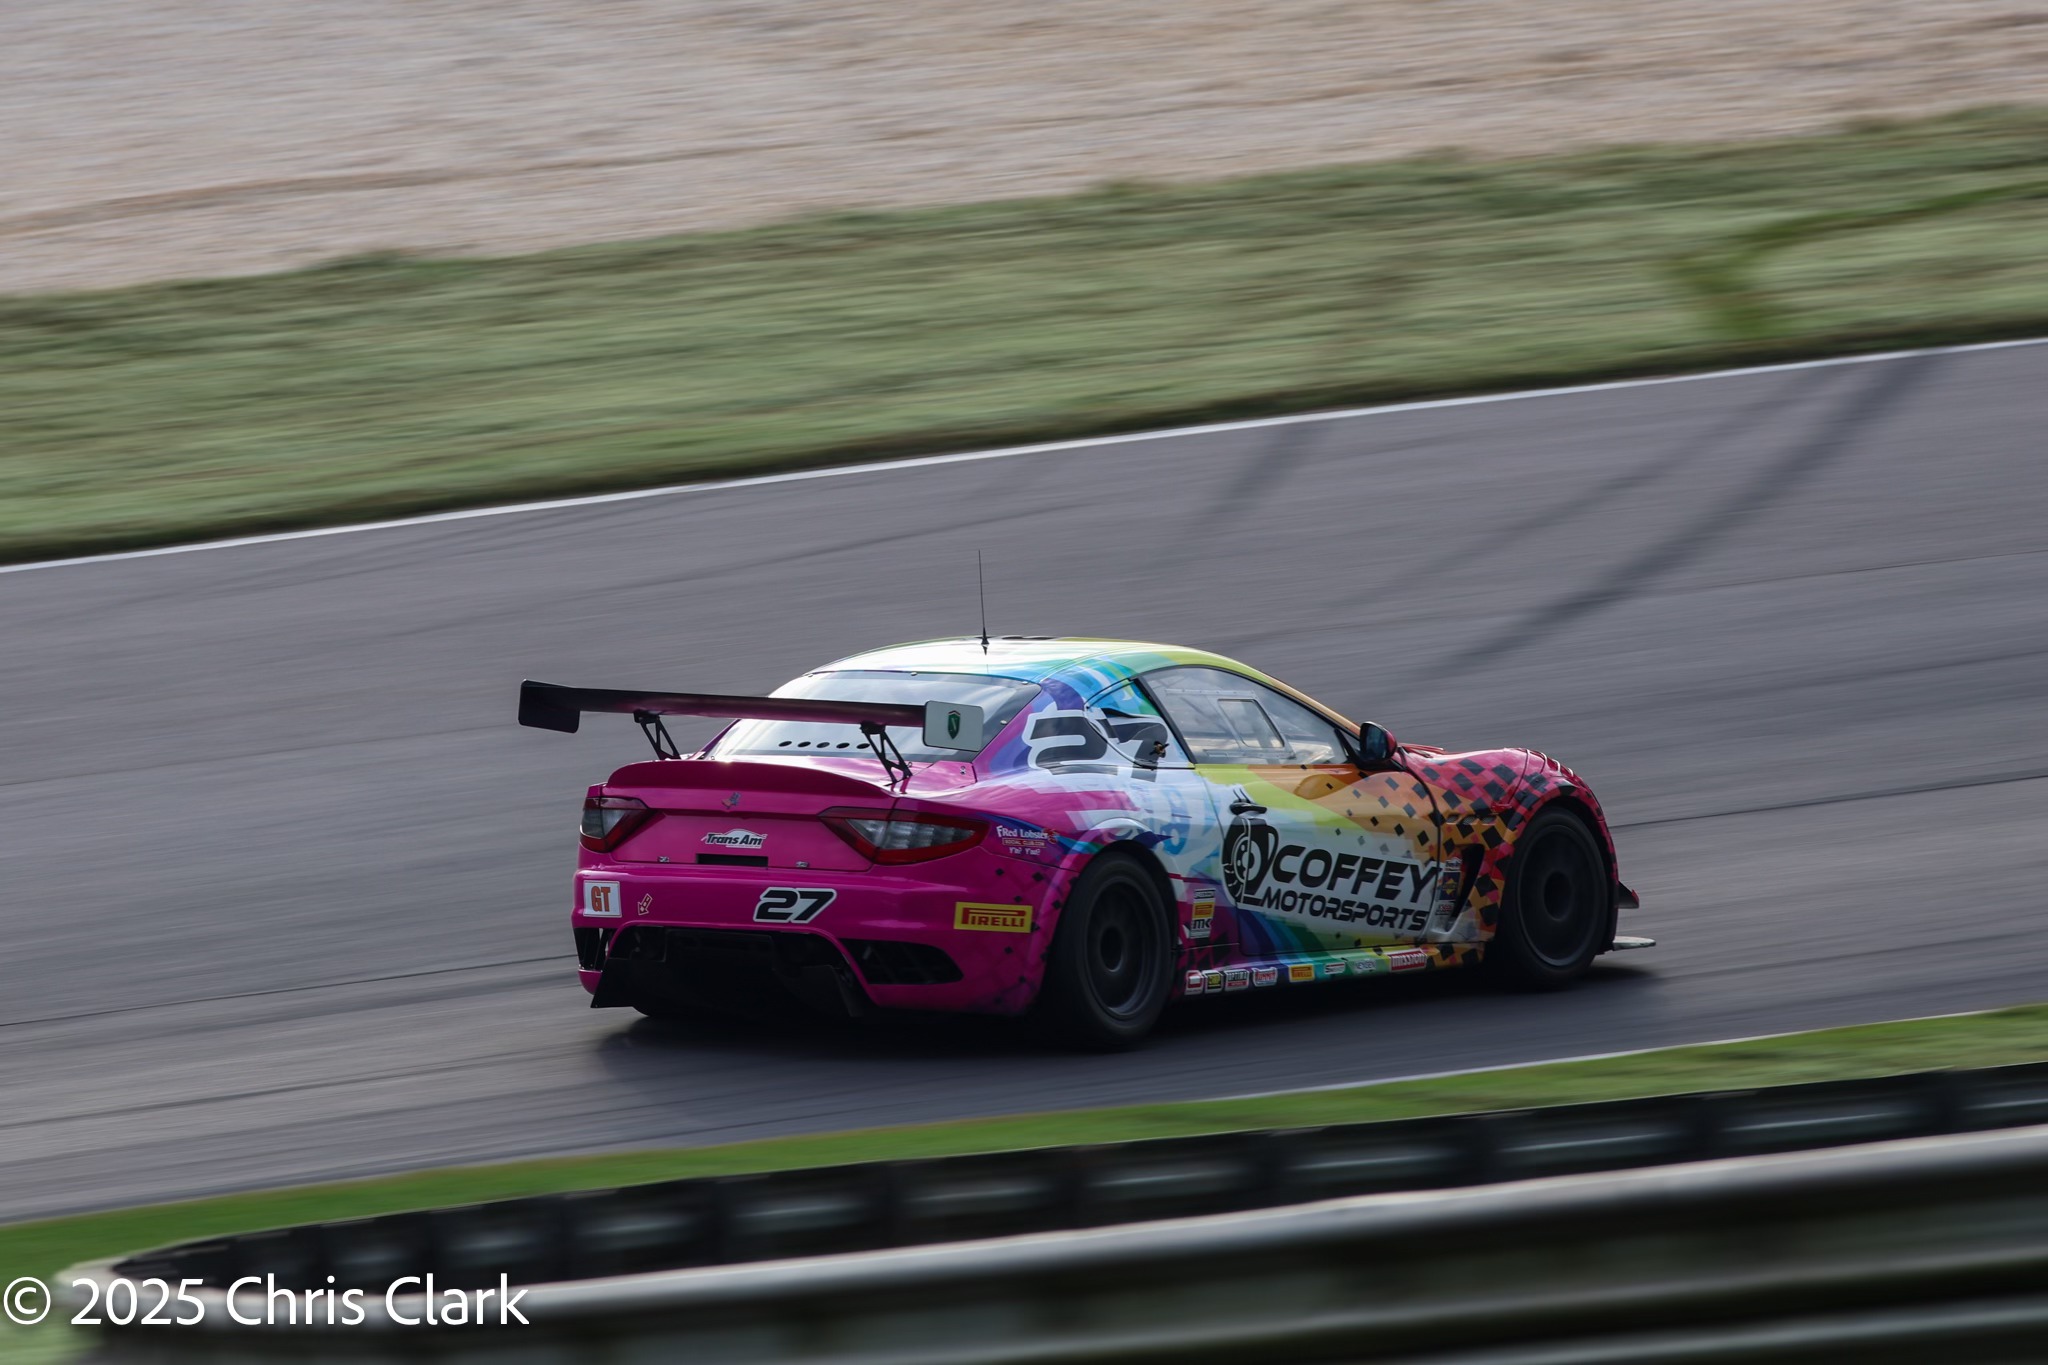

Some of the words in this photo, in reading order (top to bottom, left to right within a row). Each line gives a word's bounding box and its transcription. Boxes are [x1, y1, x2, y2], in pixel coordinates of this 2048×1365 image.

[706, 833, 739, 845] Trans
[738, 834, 763, 846] Am
[1272, 844, 1443, 903] COFFEY
[590, 885, 612, 912] GT
[755, 888, 836, 922] 27
[1259, 886, 1430, 931] MOTORSPORTS
[961, 907, 1027, 927] PIRELLI
